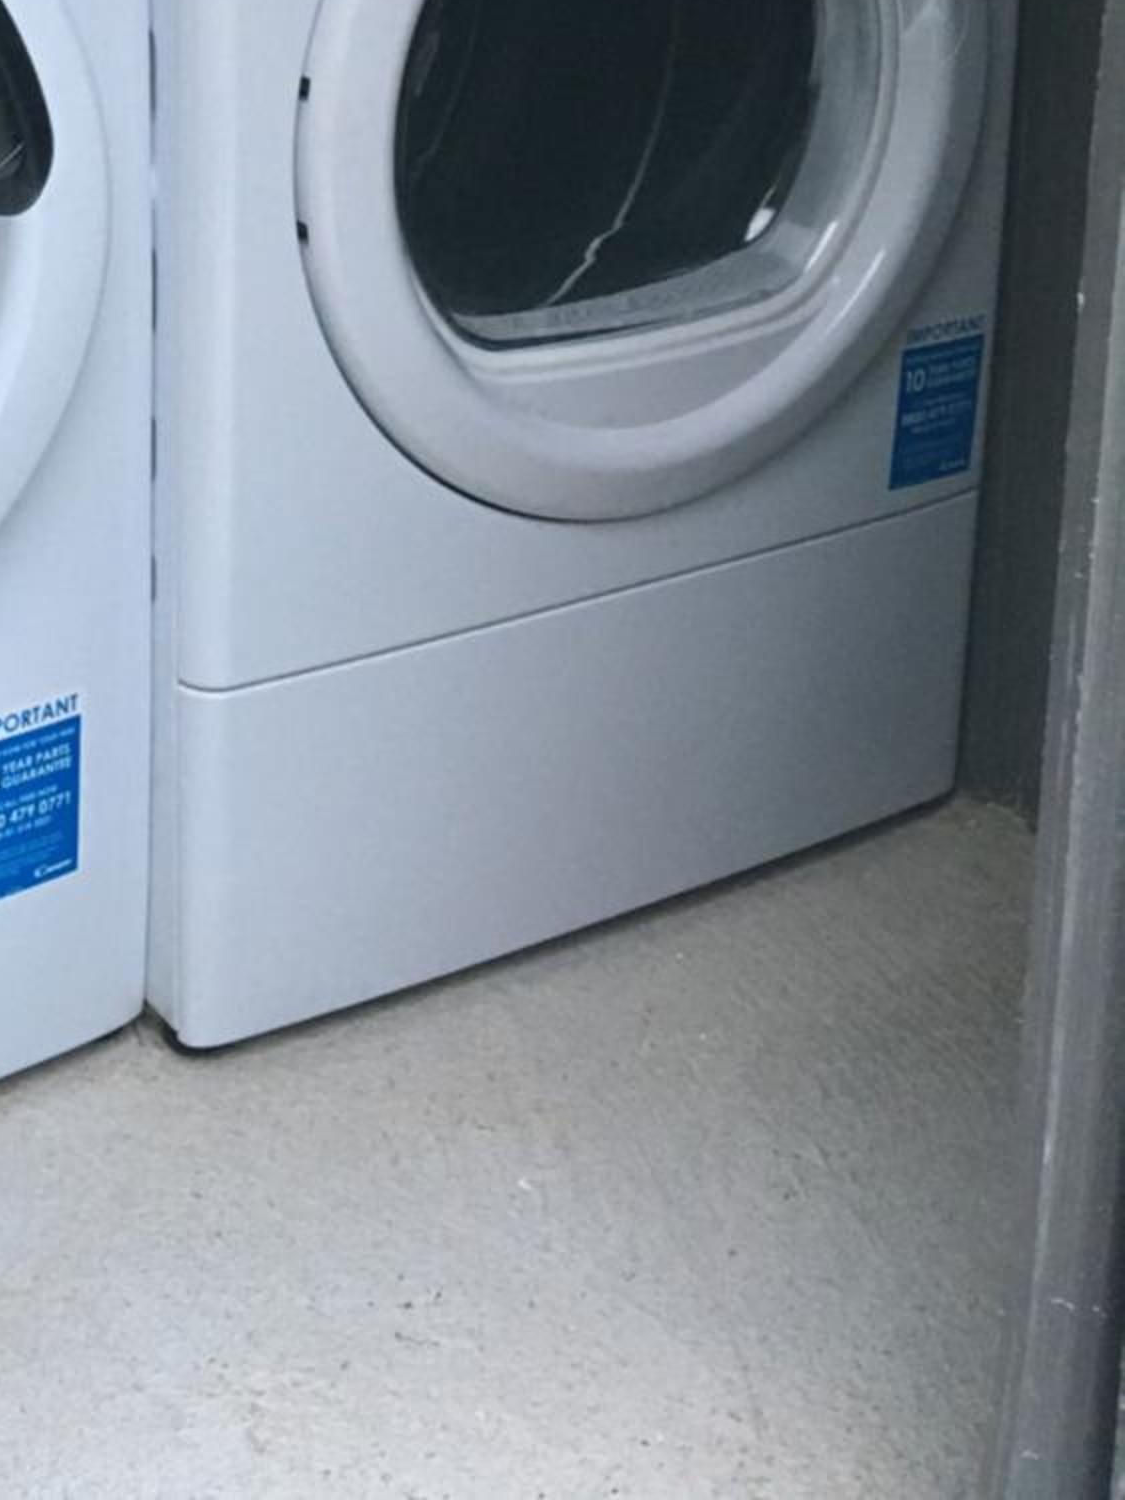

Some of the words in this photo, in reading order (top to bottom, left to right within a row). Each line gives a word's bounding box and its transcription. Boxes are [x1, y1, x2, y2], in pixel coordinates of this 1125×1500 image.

[906, 368, 926, 394] 10
[1, 755, 72, 789] GUARANTEE
[2, 754, 34, 774] YEAR
[35, 743, 70, 764] PARTS
[9, 803, 35, 823] 479
[38, 790, 72, 815] 0771
